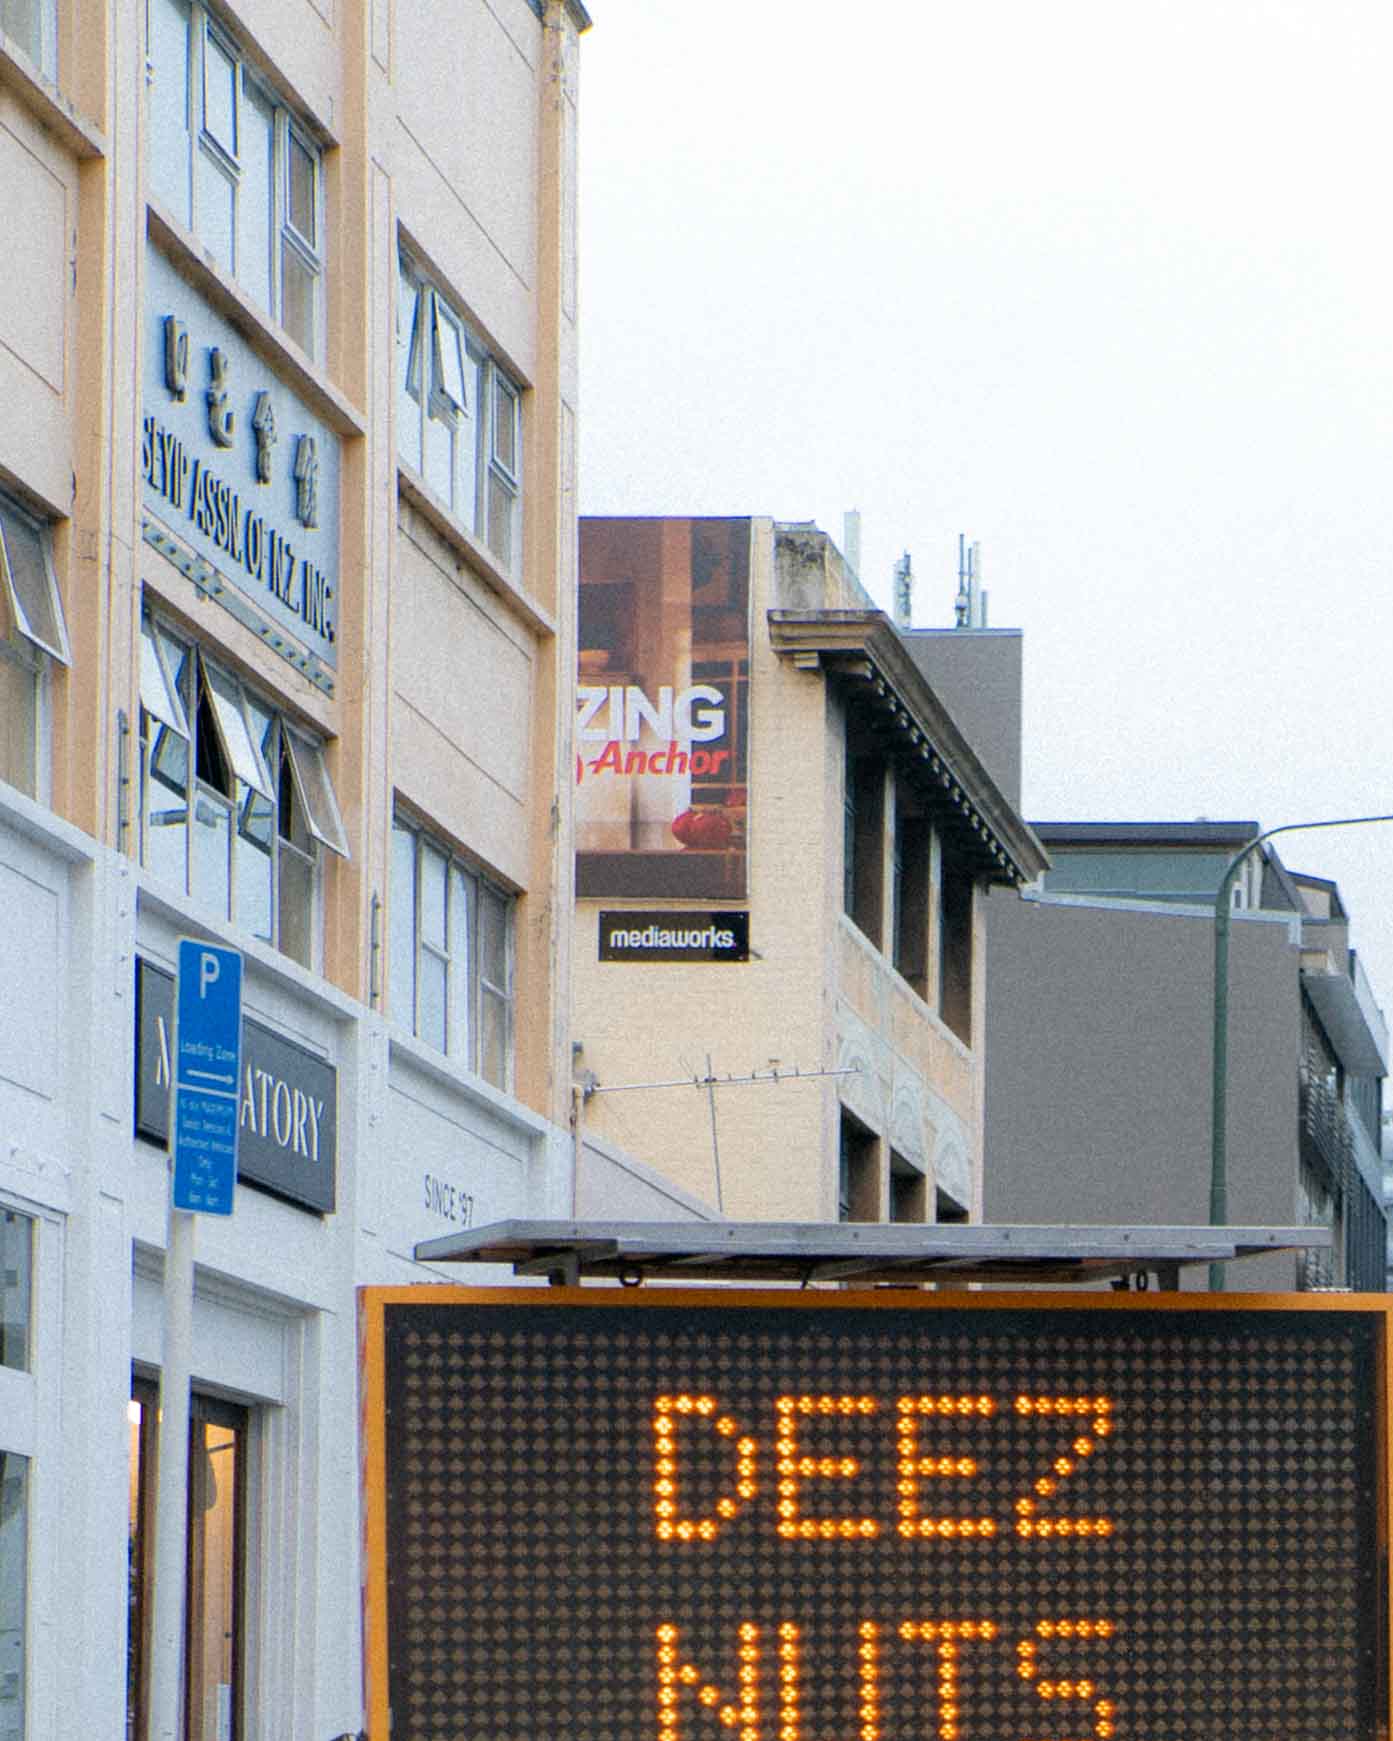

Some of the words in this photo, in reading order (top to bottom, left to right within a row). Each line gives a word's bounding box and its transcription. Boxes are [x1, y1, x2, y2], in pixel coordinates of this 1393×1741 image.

[589, 740, 729, 776] Anchor
[200, 951, 220, 999] P
[425, 1174, 456, 1221] SINCE
[654, 1395, 1113, 1540] DEEZ
